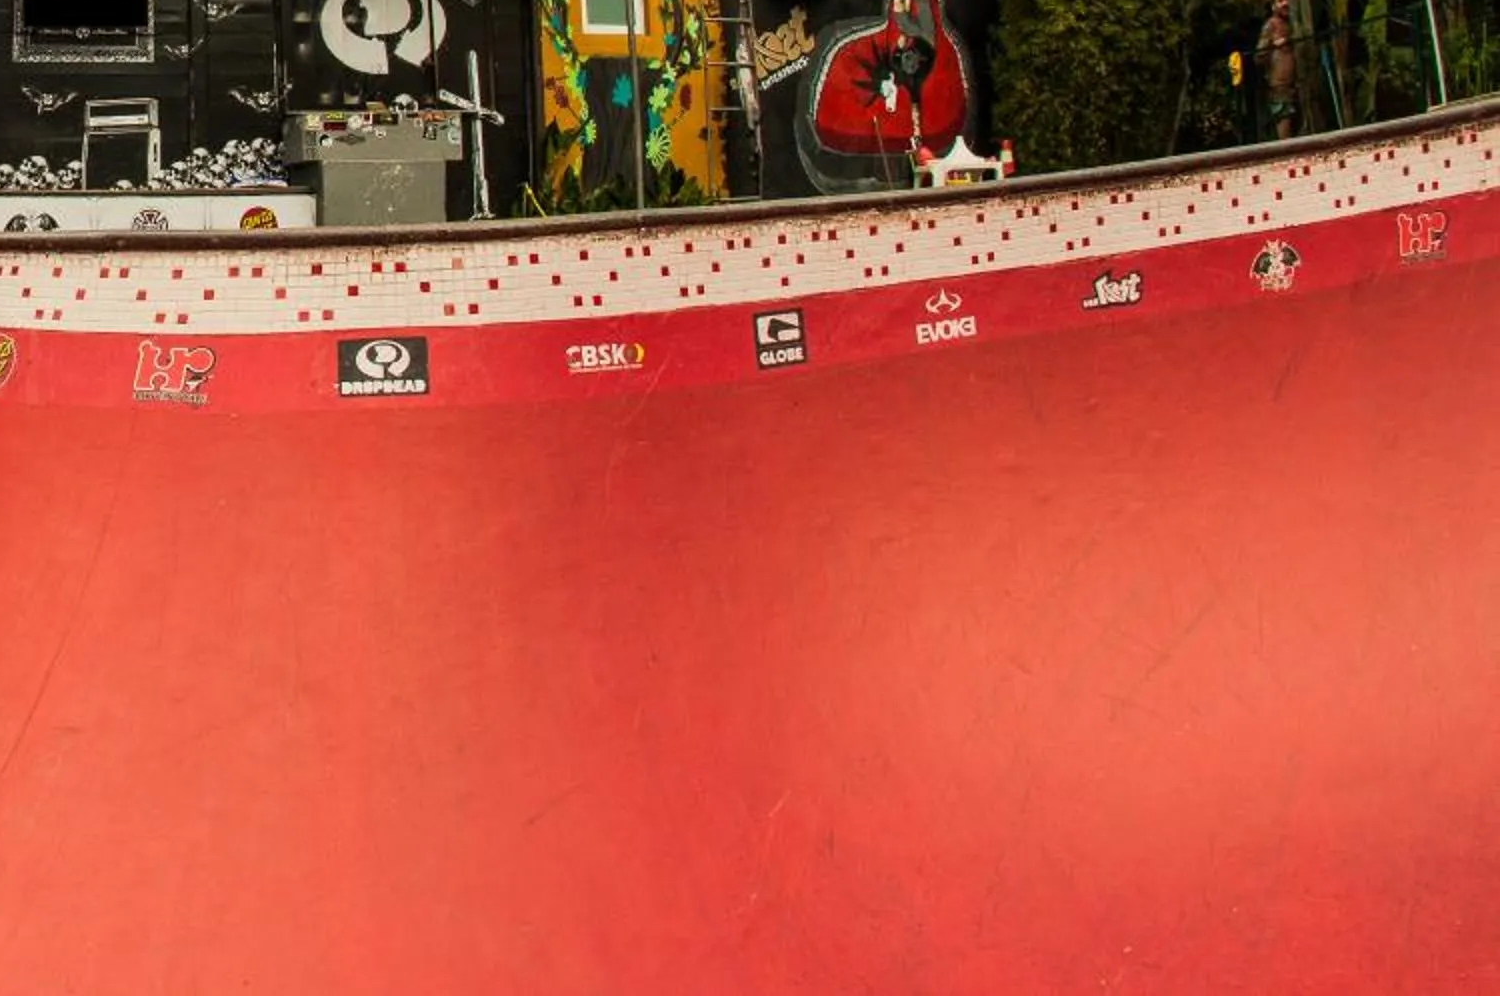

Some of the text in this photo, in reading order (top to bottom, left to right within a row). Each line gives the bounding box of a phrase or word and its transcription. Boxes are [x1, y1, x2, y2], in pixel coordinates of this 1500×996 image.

[915, 316, 977, 345] EVOKE
[759, 347, 804, 365] GLOBE
[341, 379, 426, 395] DROPDEAD
